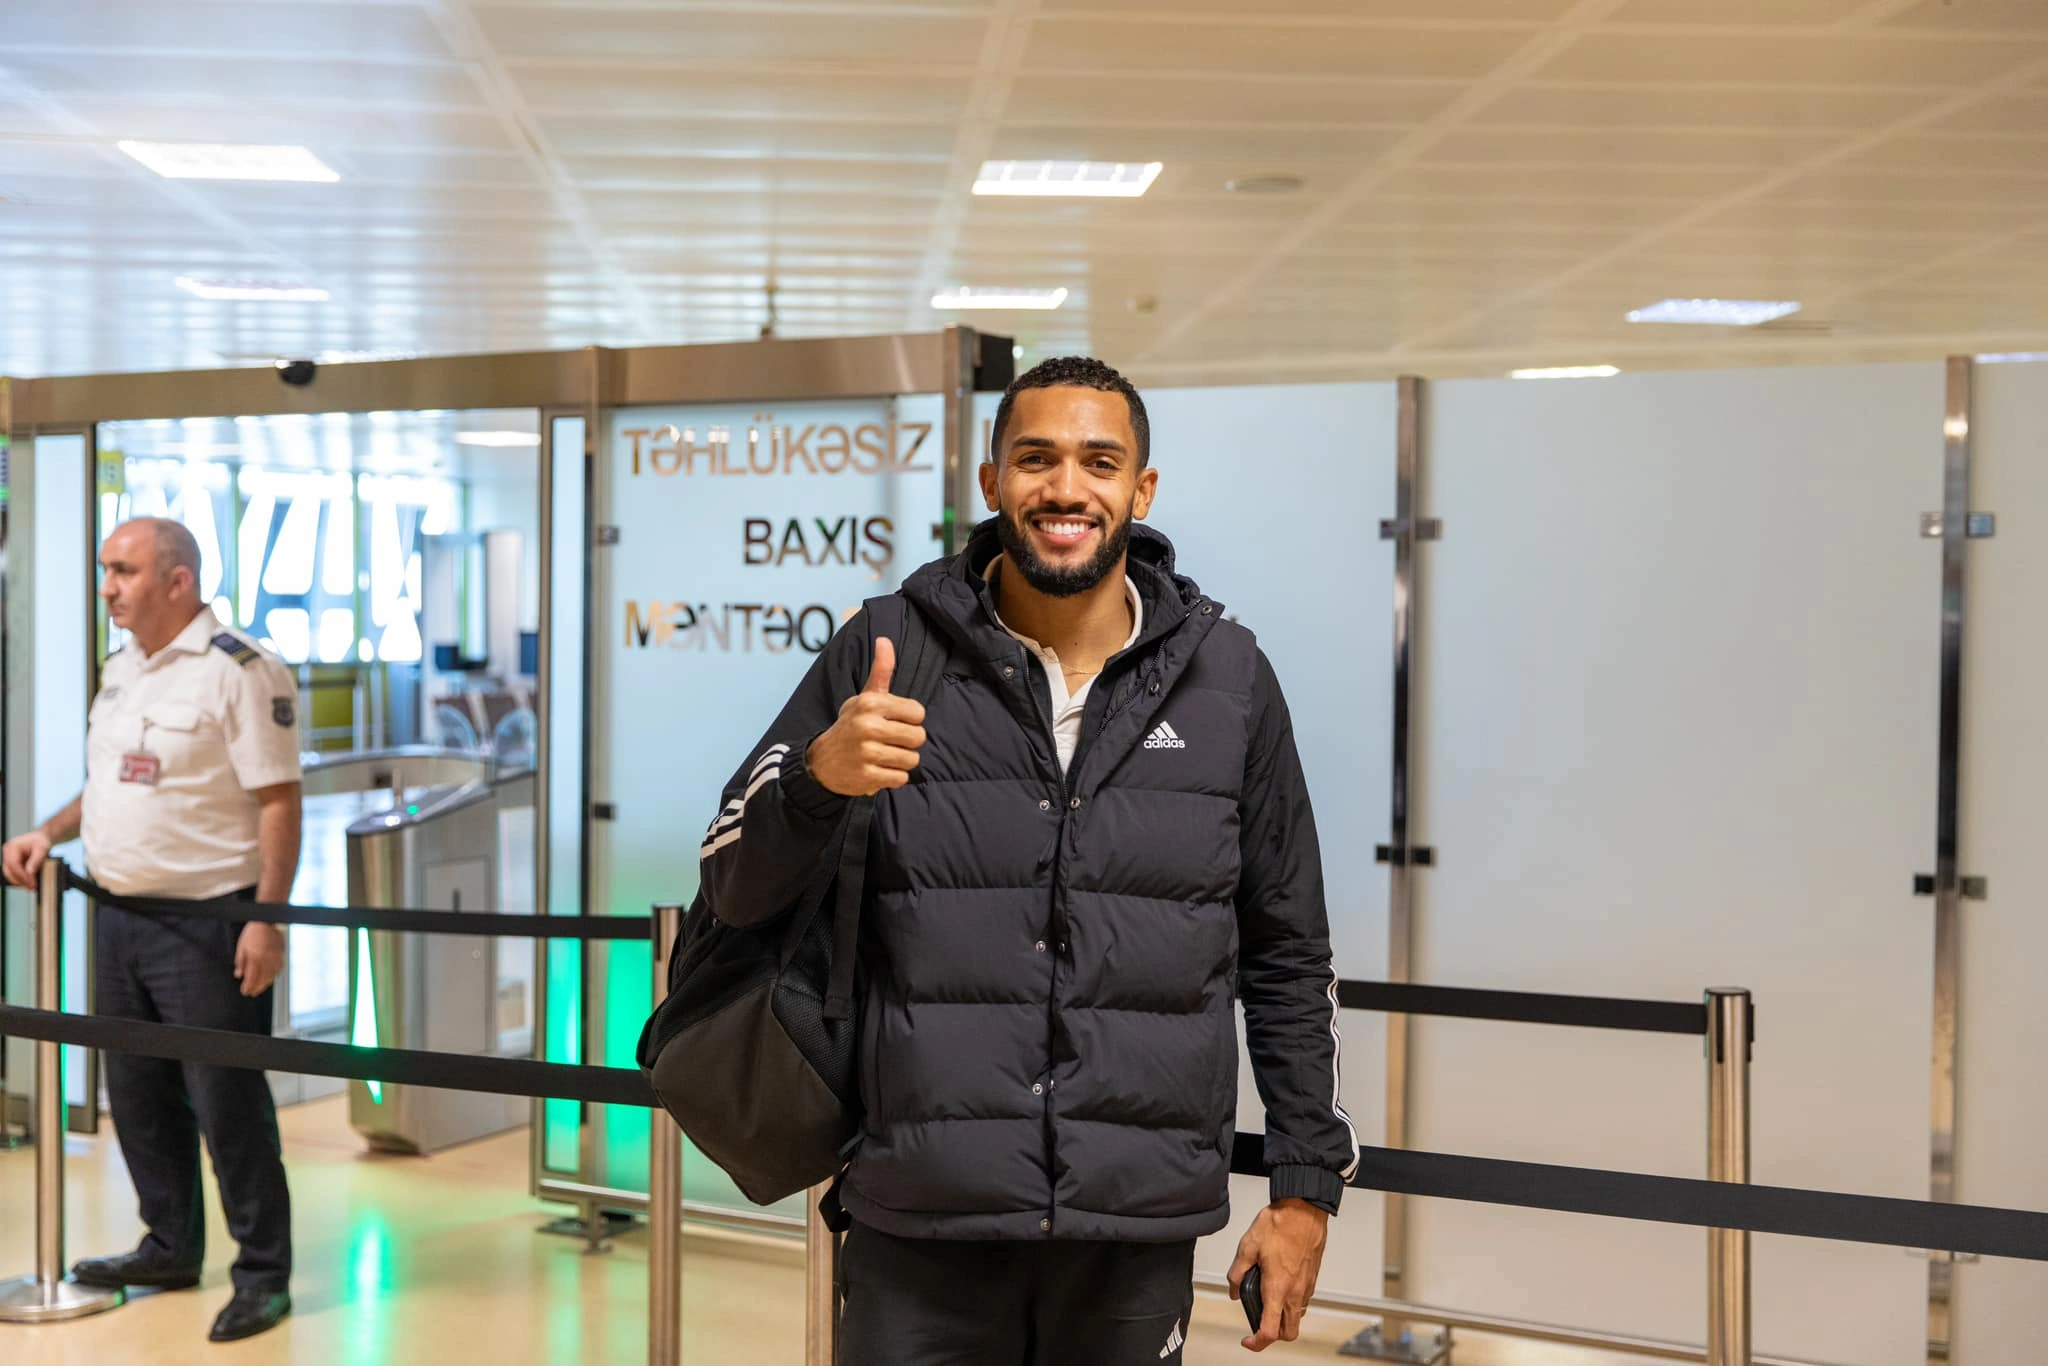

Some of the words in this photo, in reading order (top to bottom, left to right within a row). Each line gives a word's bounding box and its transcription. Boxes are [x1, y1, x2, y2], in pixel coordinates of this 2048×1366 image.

[743, 516, 894, 581] BAXIŞ
[624, 600, 862, 654] MƏNTƏQ
[1143, 738, 1186, 749] adidas
